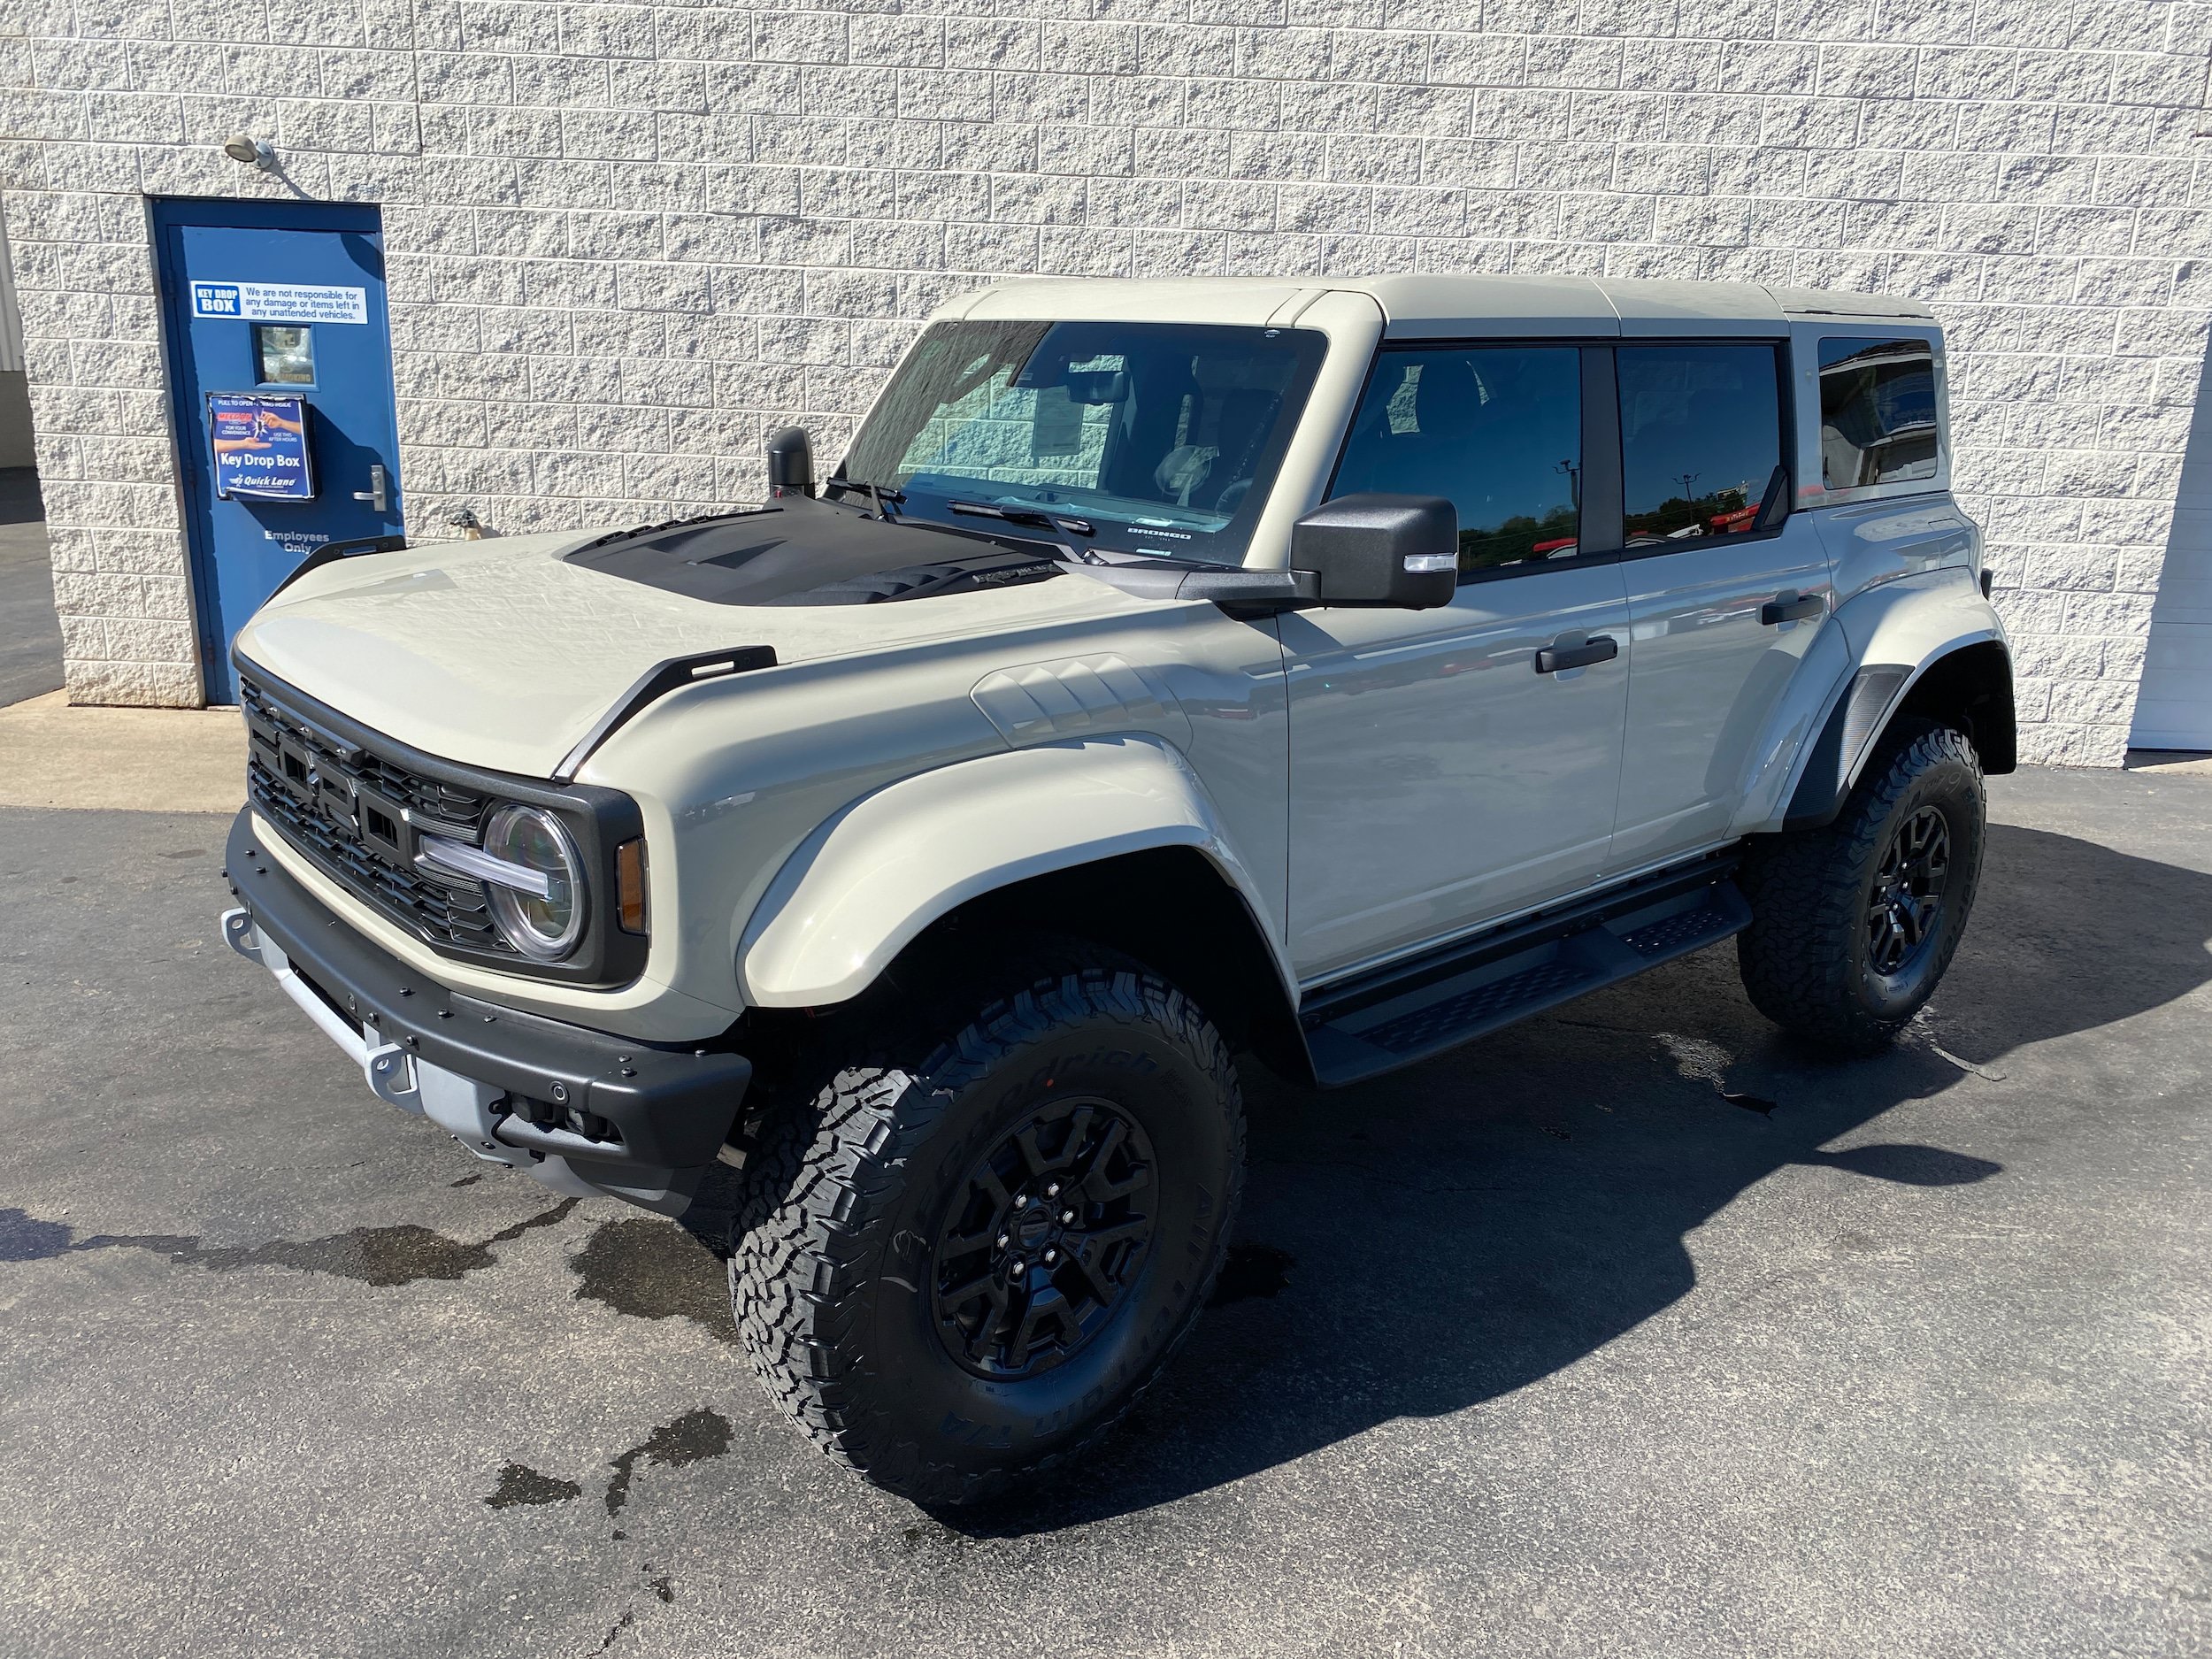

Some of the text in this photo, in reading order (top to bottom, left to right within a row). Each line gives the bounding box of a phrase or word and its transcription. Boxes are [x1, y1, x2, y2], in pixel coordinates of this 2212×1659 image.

[196, 288, 238, 300] KEY DROP
[246, 287, 261, 296] We
[279, 289, 292, 298] not
[295, 290, 342, 301] responsible
[345, 290, 357, 300] for
[202, 299, 236, 312] BOX
[264, 298, 297, 309] damage
[311, 299, 334, 309] items
[336, 301, 350, 310] left
[252, 308, 356, 319] any unattended vehicles.
[220, 452, 301, 469] Key Drop Box
[244, 475, 296, 486] Quick Lane
[265, 530, 330, 542] Employees
[1127, 528, 1192, 540] BRONCO
[284, 542, 311, 555] Only
